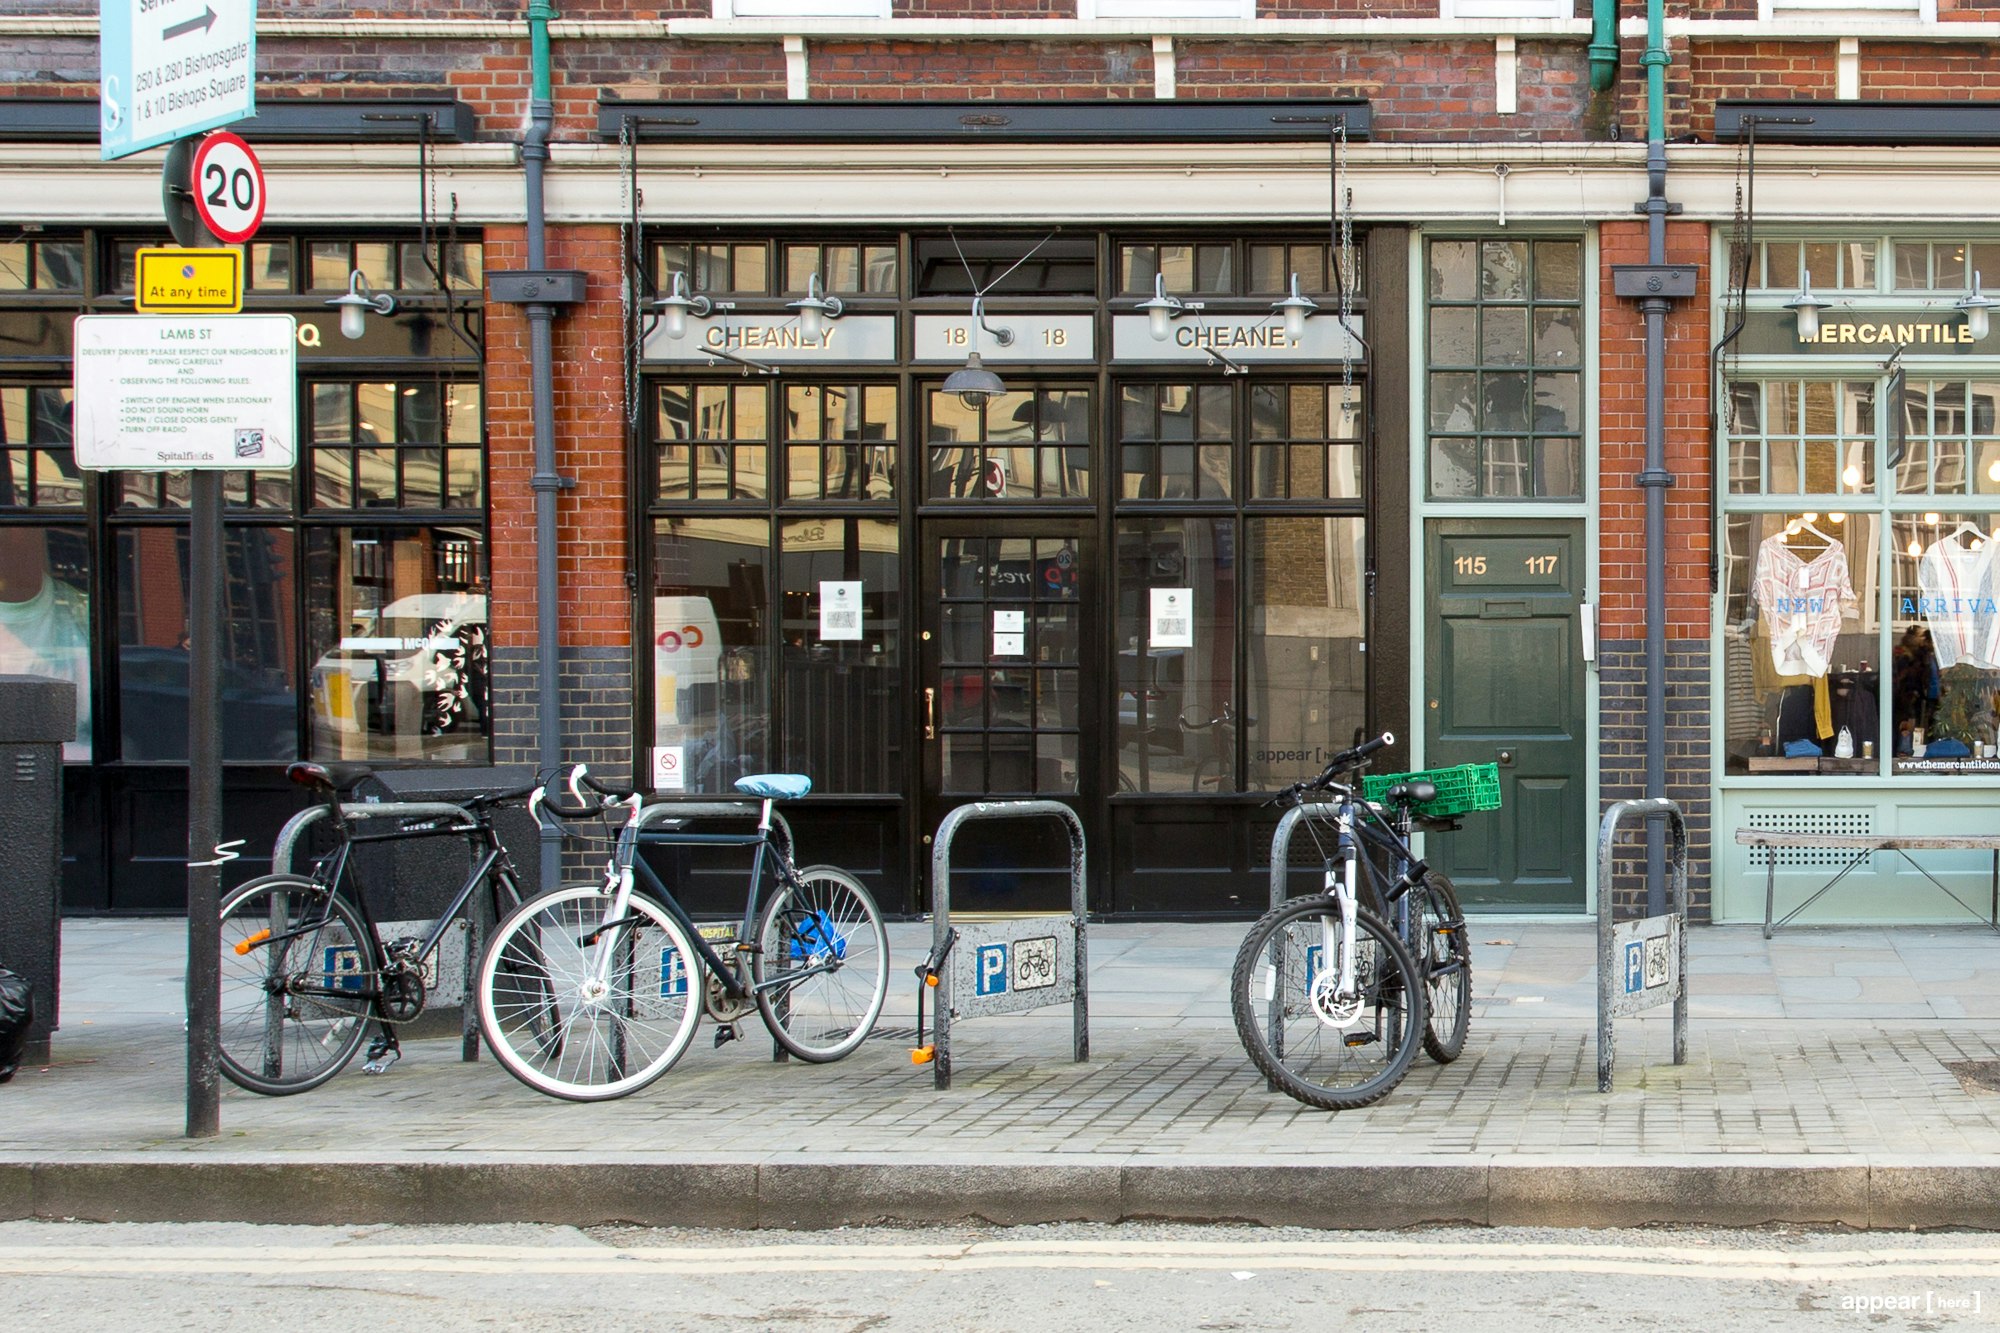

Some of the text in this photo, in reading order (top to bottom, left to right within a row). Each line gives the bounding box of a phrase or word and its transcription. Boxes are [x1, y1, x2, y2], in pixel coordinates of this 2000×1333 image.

[136, 42, 248, 92] 250 & 280 Bishopsgate
[136, 74, 246, 121] 1 & 10 Bishops Square
[205, 163, 254, 211] 20
[150, 286, 227, 299] At any time
[160, 328, 212, 340] LAMB ST
[943, 327, 1067, 347] 18 18
[1175, 326, 1299, 349] CHEANE
[82, 348, 116, 356] DELIVERY
[119, 348, 148, 356] DRIVERS
[151, 348, 176, 356] PLEASE
[179, 348, 209, 356] RESPECT
[211, 348, 227, 356] OUR
[229, 348, 278, 356] NEIGHBOURS
[148, 358, 223, 366] DRIVING CAREFULLY
[125, 416, 146, 424] OPEN
[154, 416, 178, 424] CLOSE
[180, 416, 208, 424] DOORS
[210, 416, 238, 424] GENTLY
[125, 426, 188, 434] TURN OFF RADIO
[1454, 555, 1558, 575] 115 117
[1777, 598, 1824, 614] NEW
[1256, 750, 1312, 764] appear
[983, 948, 1004, 993] P
[1629, 947, 1641, 990] P
